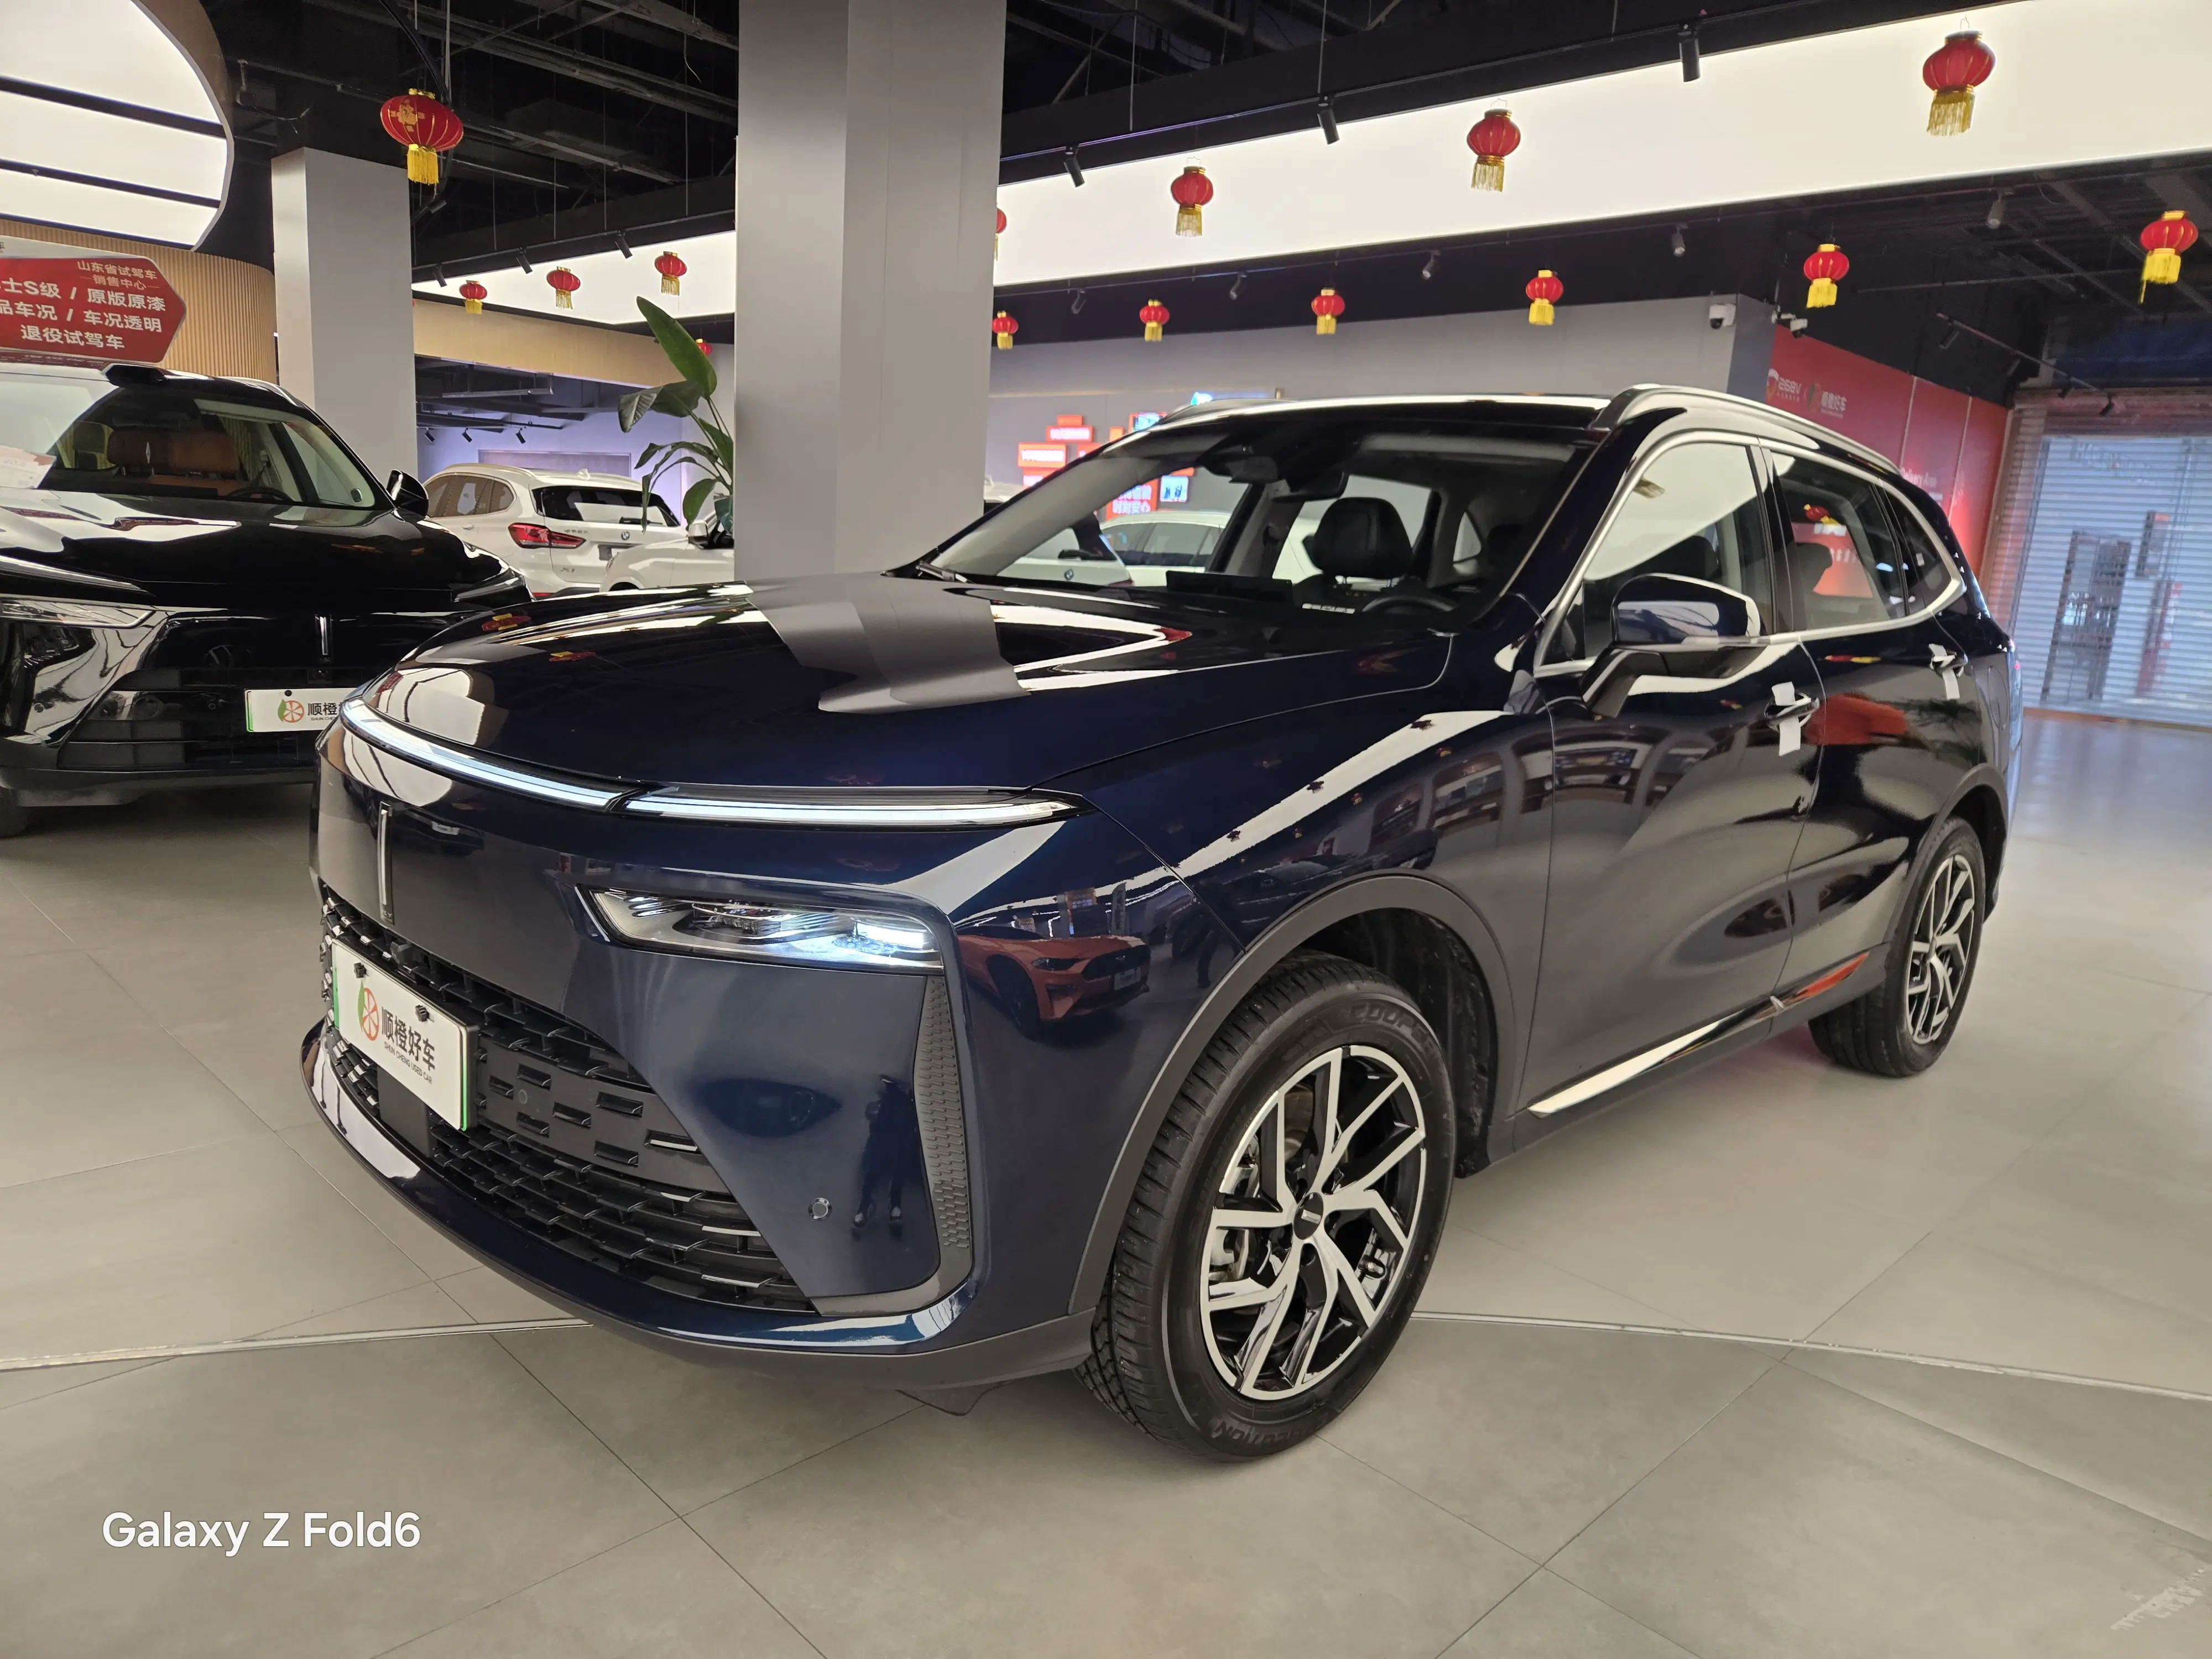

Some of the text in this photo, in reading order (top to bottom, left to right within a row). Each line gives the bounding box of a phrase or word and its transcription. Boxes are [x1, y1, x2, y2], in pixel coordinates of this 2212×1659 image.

[77, 260, 158, 280] 山东省试驾车
[92, 274, 147, 291] 销售中心
[0, 278, 61, 299] 士S级
[87, 288, 166, 312] 原版原漆
[84, 309, 163, 332] 车况透明
[20, 324, 125, 349] 退役试驾车
[307, 702, 342, 716] 顺橙
[381, 1006, 435, 1071] 顺橙好车
[384, 1041, 432, 1084] SHUN CHENG USED CAR
